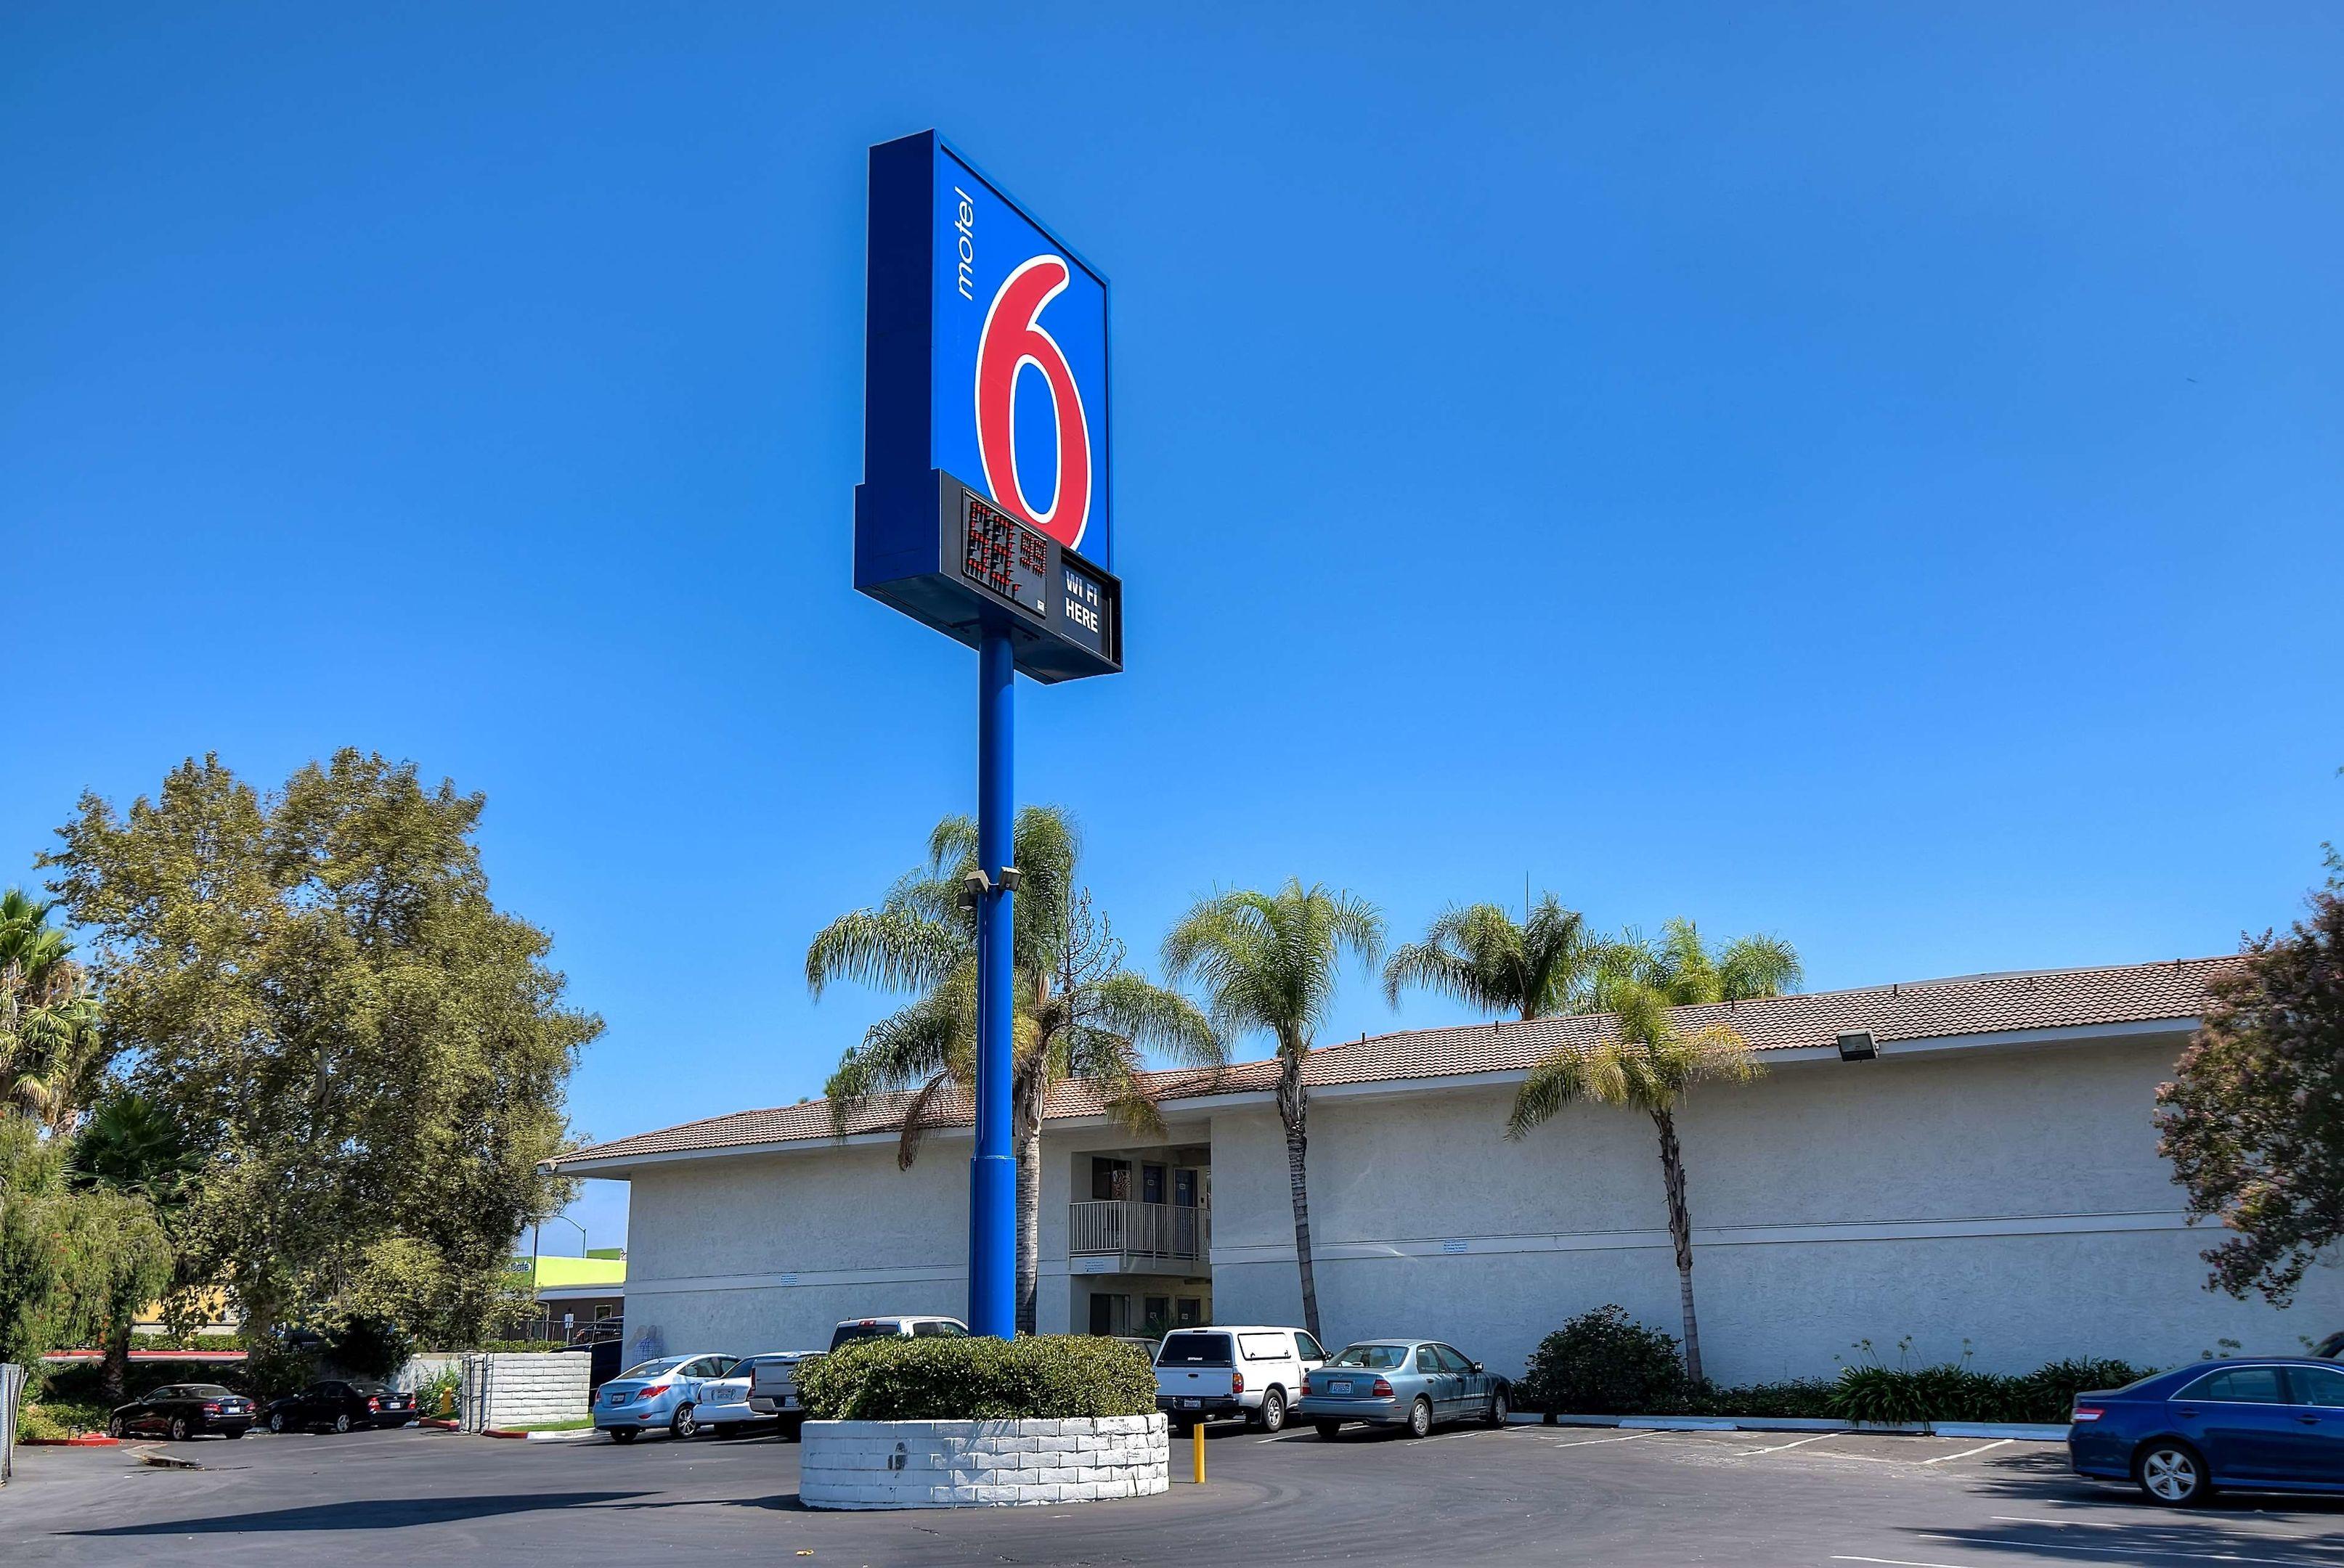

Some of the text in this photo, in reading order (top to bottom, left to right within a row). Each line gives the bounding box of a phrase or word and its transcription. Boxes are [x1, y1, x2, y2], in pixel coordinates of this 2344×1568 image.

[955, 187, 974, 301] motel
[974, 254, 1092, 558] 6
[1065, 597, 1098, 633] HERE
[1086, 583, 1098, 607] FI
